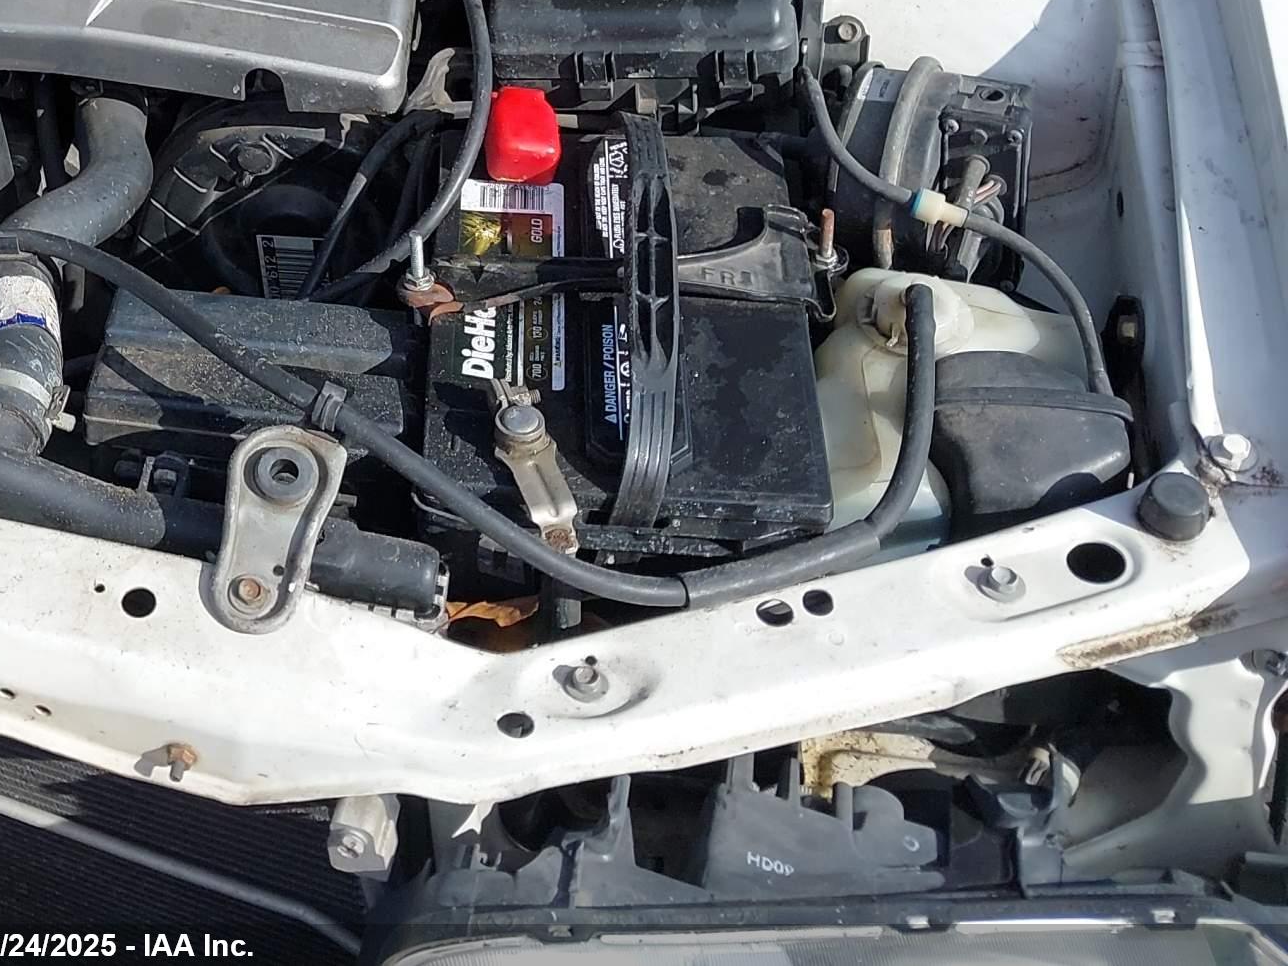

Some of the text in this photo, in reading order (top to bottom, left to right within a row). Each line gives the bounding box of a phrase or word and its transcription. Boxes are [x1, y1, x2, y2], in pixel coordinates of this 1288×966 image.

[530, 218, 543, 243] GOLD
[460, 305, 497, 379] DieHa
[601, 324, 615, 361] POISON
[532, 363, 542, 379] 700
[603, 370, 617, 413] DANGER
